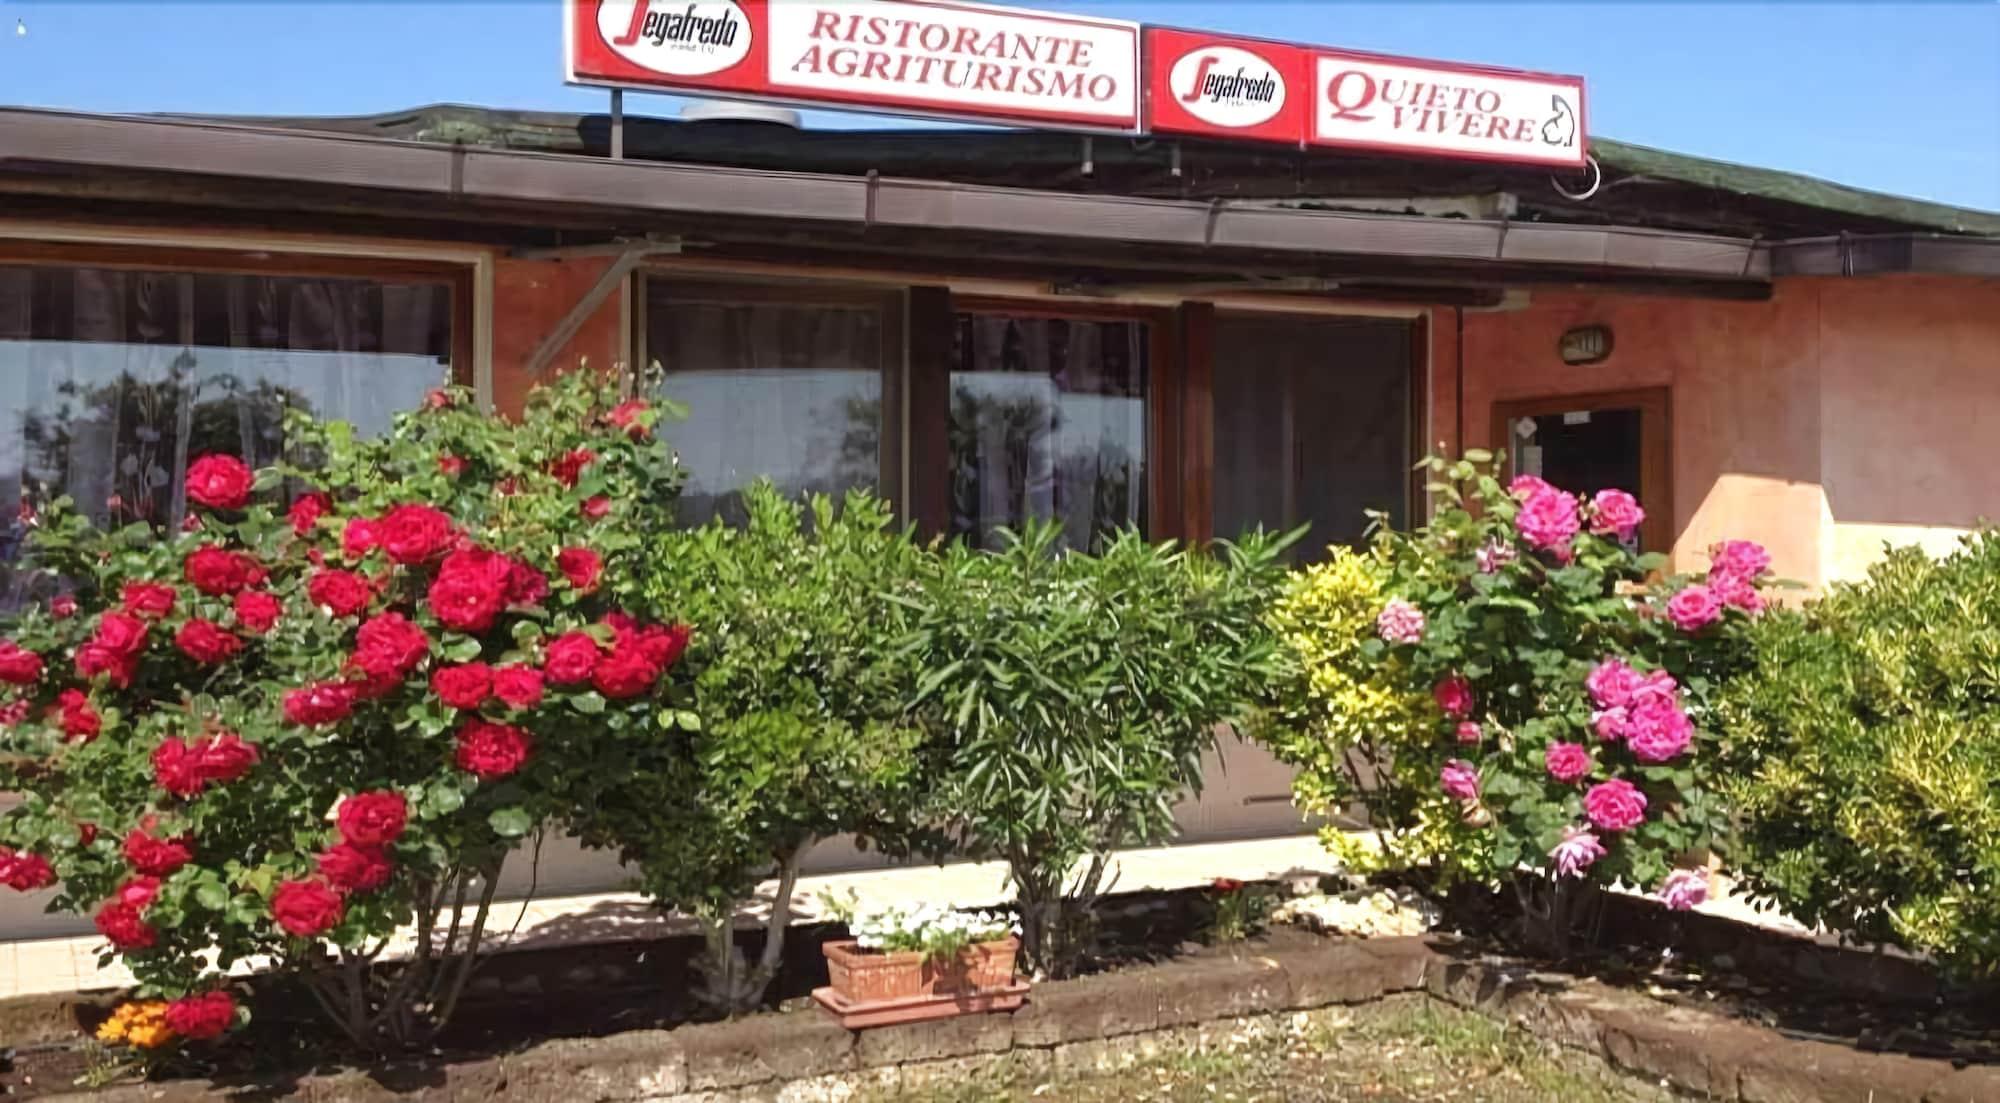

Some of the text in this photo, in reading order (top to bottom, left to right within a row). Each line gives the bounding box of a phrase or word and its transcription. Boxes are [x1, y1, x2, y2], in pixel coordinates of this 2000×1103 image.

[613, 0, 738, 48] Segafredo
[808, 9, 1094, 68] RISTORANTE
[791, 44, 1117, 102] AGRITURISMO
[1182, 56, 1276, 103] Segafredo
[1327, 70, 1502, 122] QUIETO
[1392, 105, 1537, 143] VIVERE
